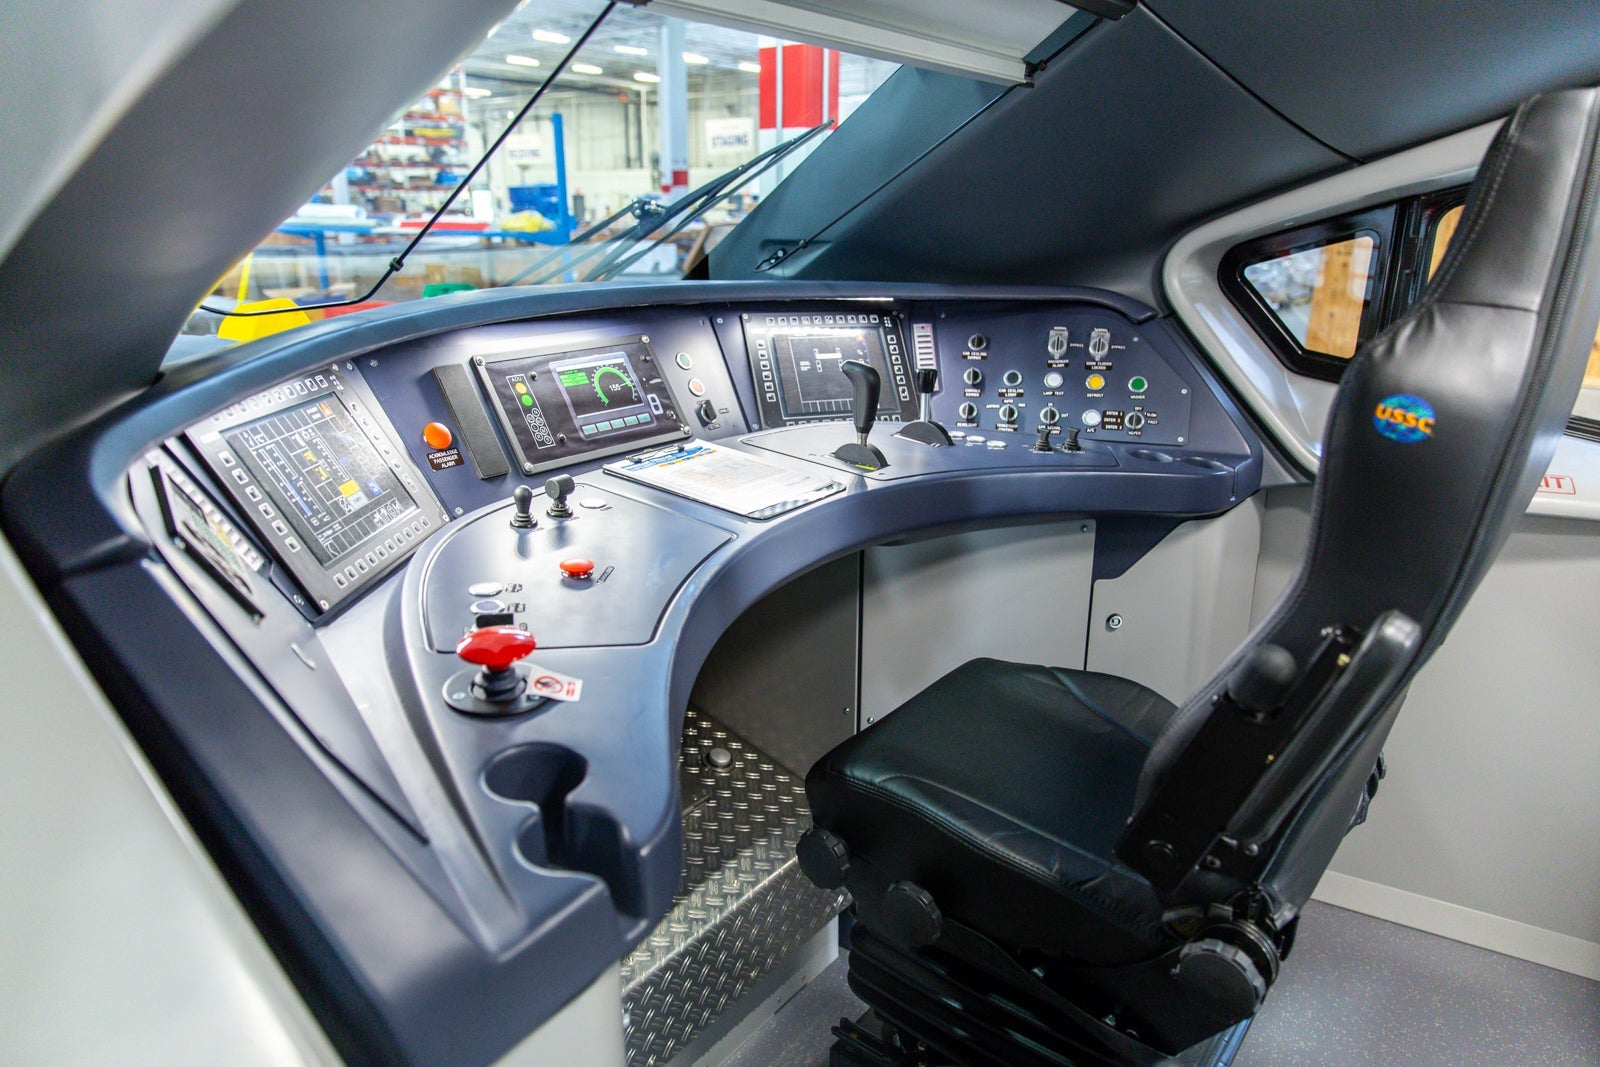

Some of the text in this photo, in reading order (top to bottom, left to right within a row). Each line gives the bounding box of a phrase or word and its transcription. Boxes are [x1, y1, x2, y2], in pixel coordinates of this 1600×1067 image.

[609, 384, 621, 392] 155
[1375, 403, 1435, 434] USSC
[428, 448, 458, 459] ACKNOWLEDGE
[434, 455, 459, 464] PASSENGER
